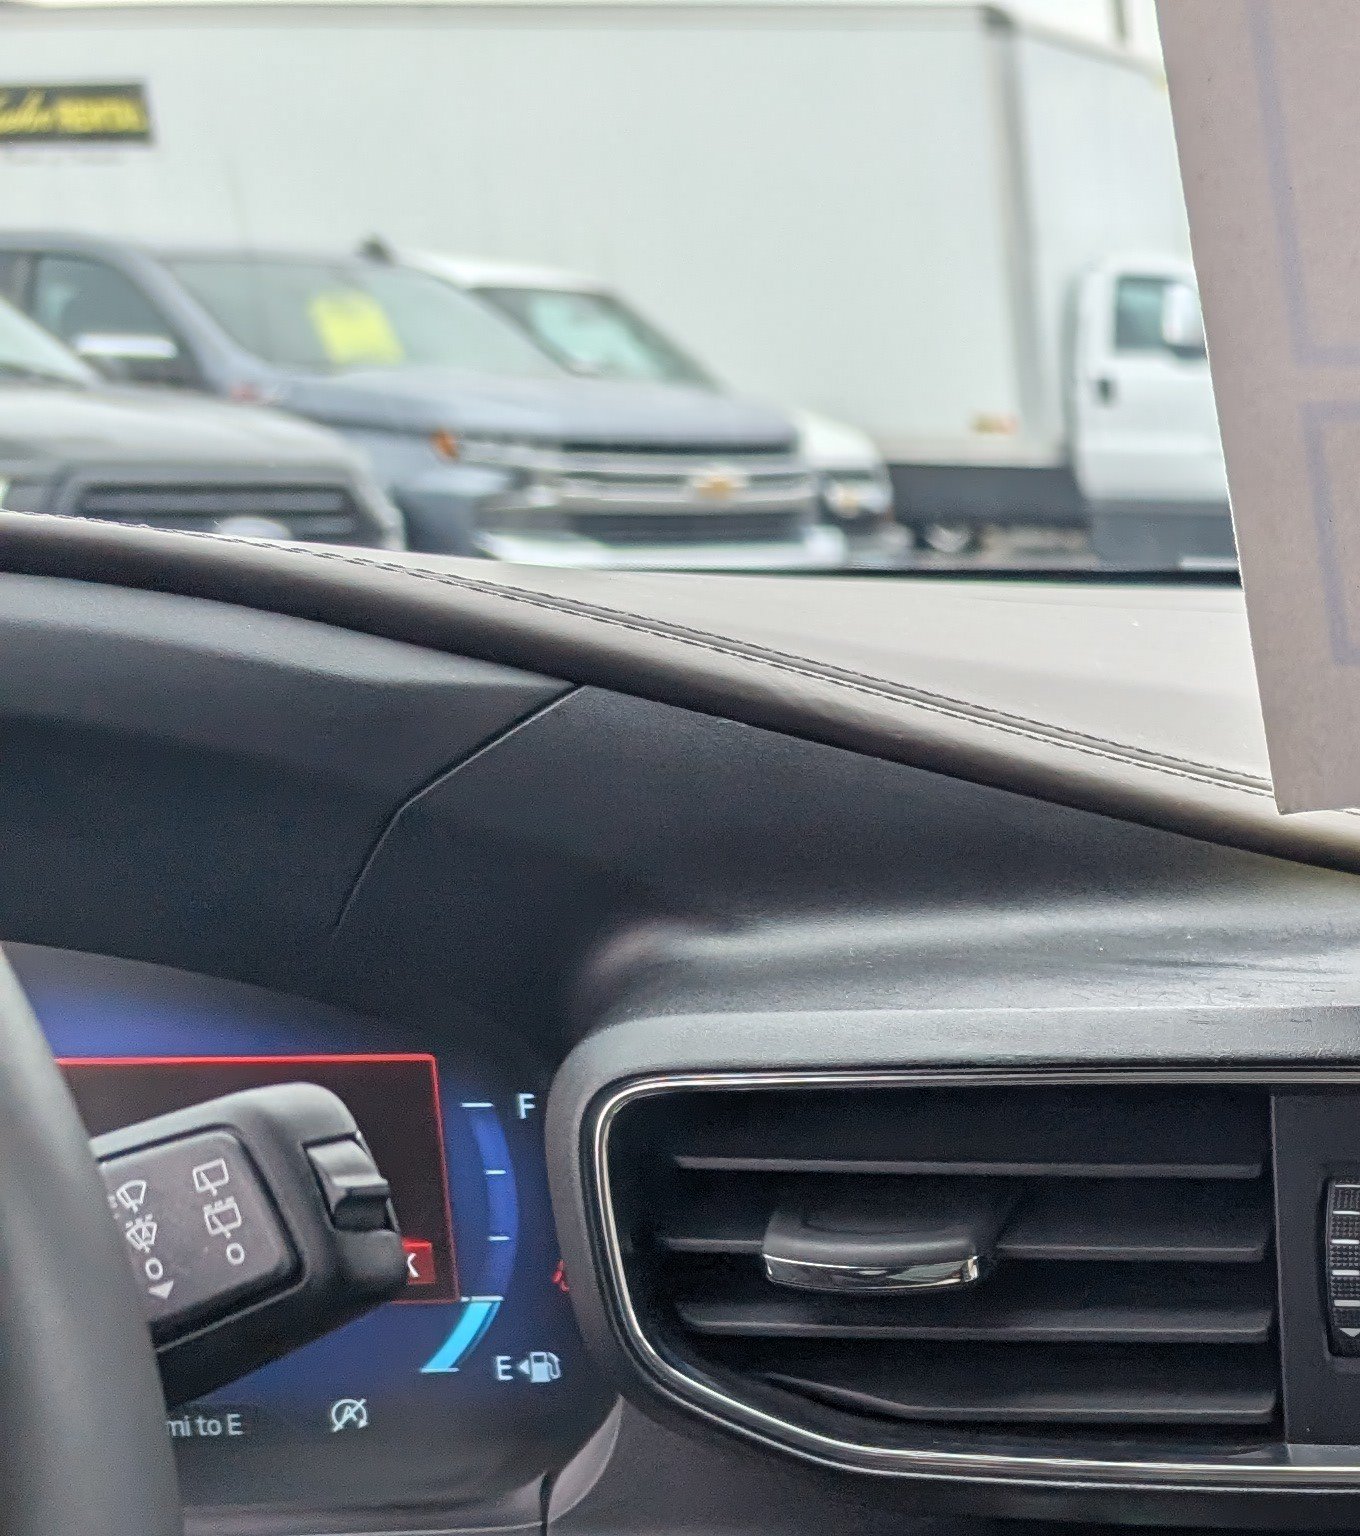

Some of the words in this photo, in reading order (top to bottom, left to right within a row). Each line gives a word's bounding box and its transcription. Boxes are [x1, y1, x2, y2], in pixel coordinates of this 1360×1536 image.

[515, 1093, 537, 1120] F
[495, 1355, 514, 1381] E
[195, 1414, 223, 1436] to
[226, 1413, 244, 1436] E
